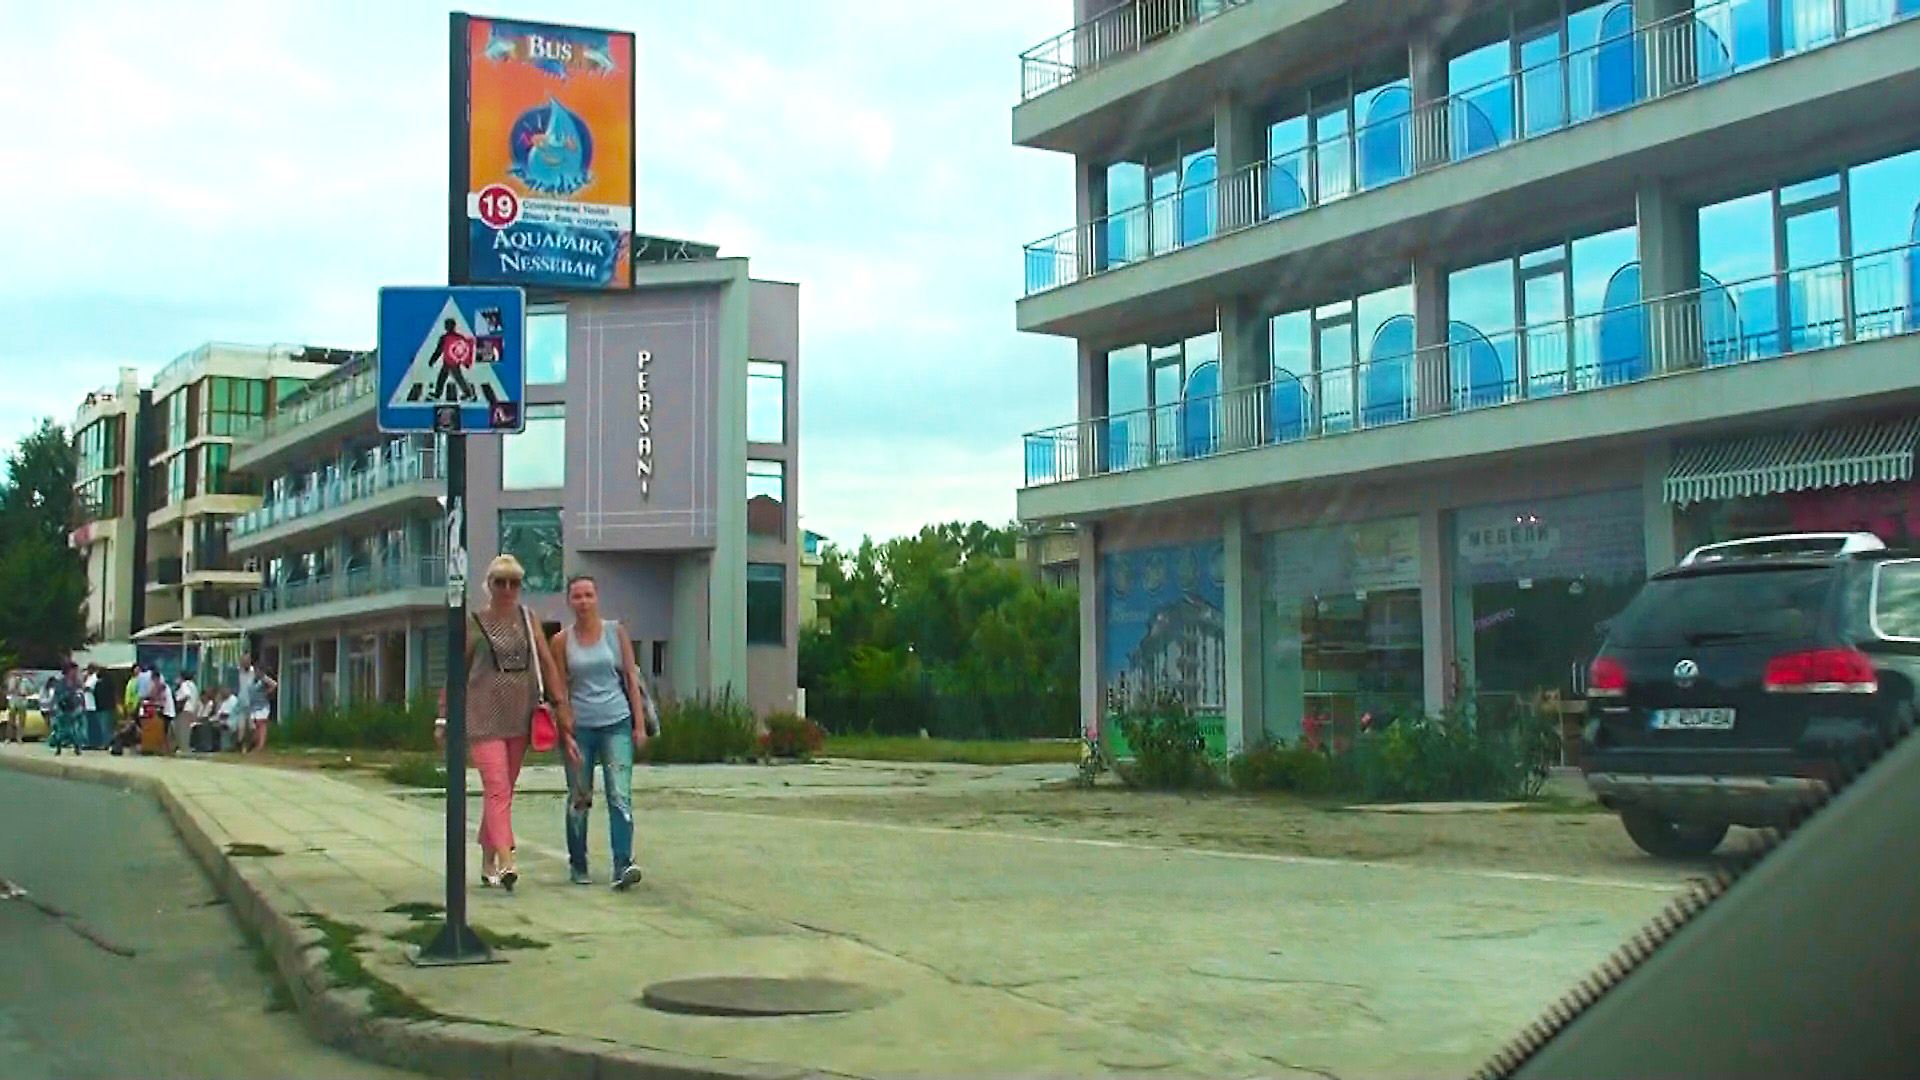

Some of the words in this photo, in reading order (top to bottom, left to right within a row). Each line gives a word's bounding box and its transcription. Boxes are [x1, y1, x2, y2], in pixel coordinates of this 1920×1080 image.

[482, 194, 514, 218] 19
[492, 229, 605, 257] AQUAPARK
[499, 252, 598, 281] NESSEBAR
[637, 349, 653, 494] PERSANI
[1468, 525, 1549, 547] МЕБЕЛИ
